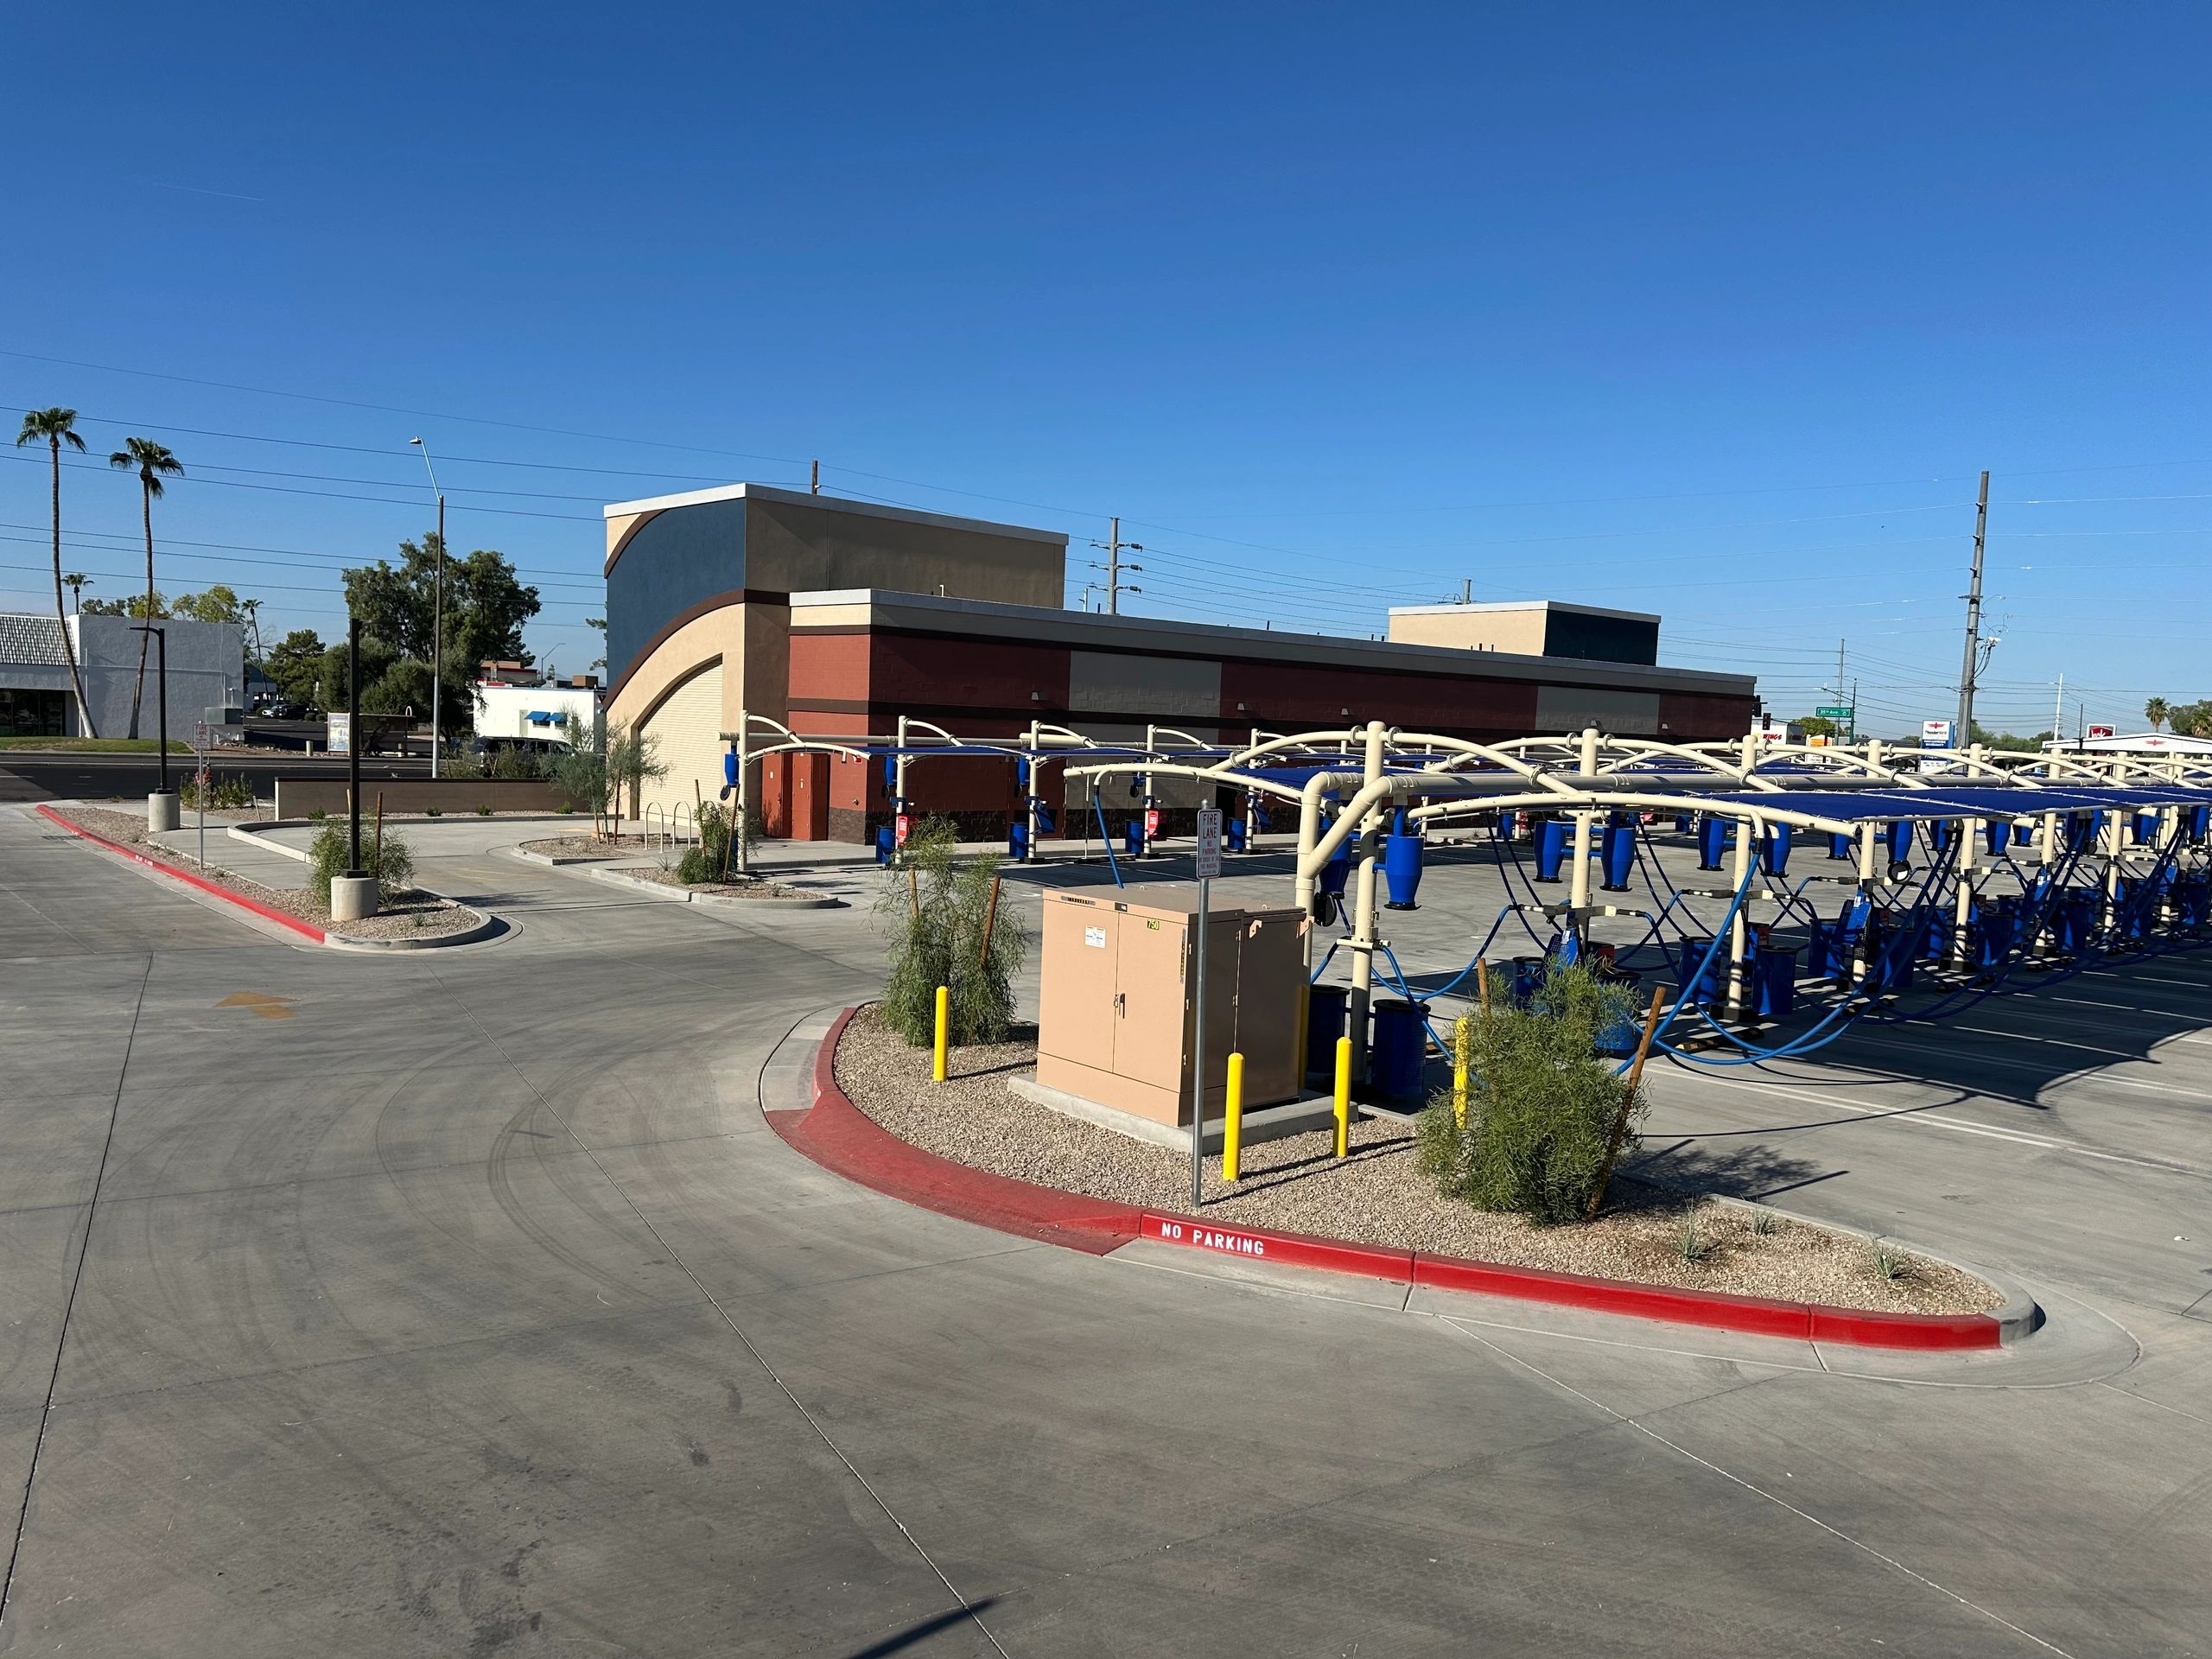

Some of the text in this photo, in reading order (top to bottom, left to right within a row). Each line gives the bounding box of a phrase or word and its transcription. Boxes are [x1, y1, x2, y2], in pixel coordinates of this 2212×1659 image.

[1203, 814, 1217, 825] FIRE
[1203, 827, 1217, 839] LANE
[1147, 919, 1160, 930] 750
[1161, 1222, 1264, 1255] NO PARKING
